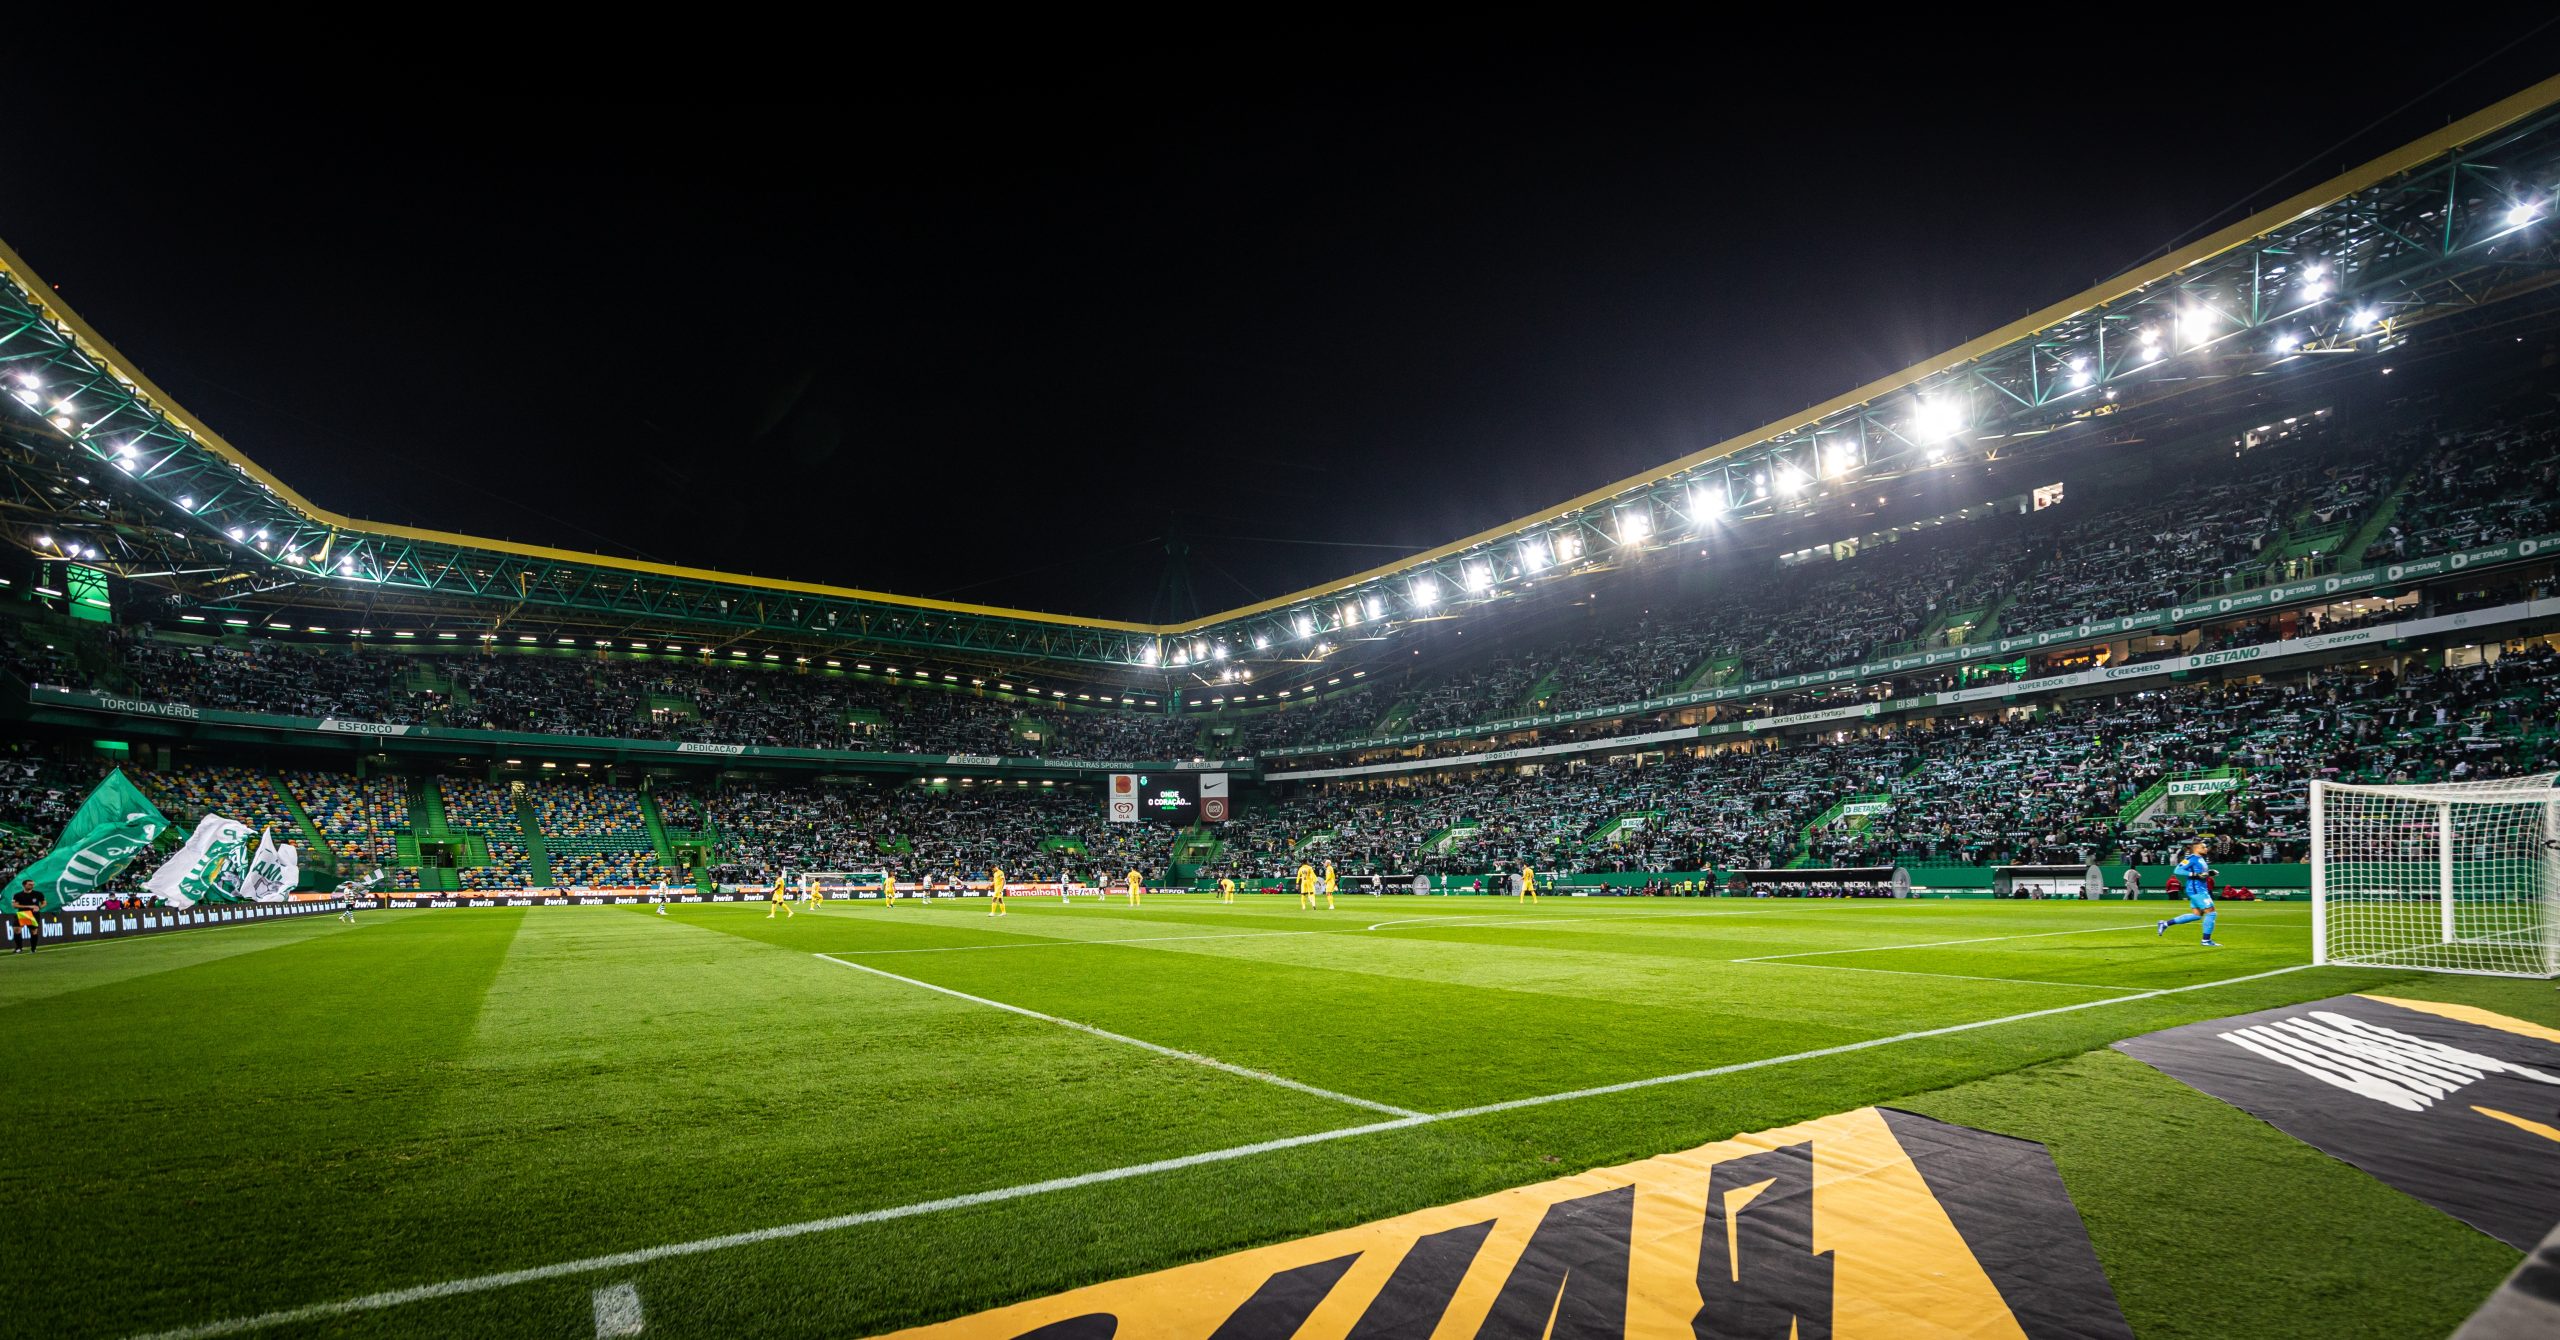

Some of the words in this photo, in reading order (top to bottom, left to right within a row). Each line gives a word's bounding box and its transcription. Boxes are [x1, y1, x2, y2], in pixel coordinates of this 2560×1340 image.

[2539, 538, 2560, 548] BETA
[2470, 548, 2508, 562] BETANO
[2405, 561, 2440, 573] BETANO
[2341, 574, 2374, 586] BETANO
[2285, 584, 2317, 596] BETANO
[2233, 595, 2262, 606] BETANO
[2185, 605, 2212, 616] BETANO
[2328, 632, 2371, 645] REPSOL
[2204, 647, 2261, 666] BETANO
[2117, 664, 2160, 677] RECHEIO
[2017, 680, 2041, 692] SUPER
[2042, 677, 2064, 687] BOCK
[100, 697, 157, 714] TORCIDA
[159, 704, 200, 719] VERDE
[1907, 698, 1919, 708] SOU
[1772, 715, 1795, 726] Sporting
[1796, 712, 1812, 722] Clube
[1044, 759, 1073, 768] BRIGADA
[1074, 760, 1099, 769] ULTRAS
[1100, 761, 1134, 769] SPORTING
[507, 898, 532, 906] bwin
[544, 897, 568, 906] bwin
[580, 896, 603, 905] bwin
[615, 895, 638, 905] bwin
[681, 895, 703, 903] bwin
[713, 894, 734, 902] bwin
[743, 893, 764, 901] bwin
[355, 899, 377, 908] bwin
[390, 899, 417, 908] bwin
[430, 899, 457, 908] bwin
[469, 899, 495, 907] bwin
[73, 915, 92, 935] bwin
[100, 913, 116, 933] bwin
[122, 912, 138, 930] bwin
[42, 917, 63, 937] bwin
